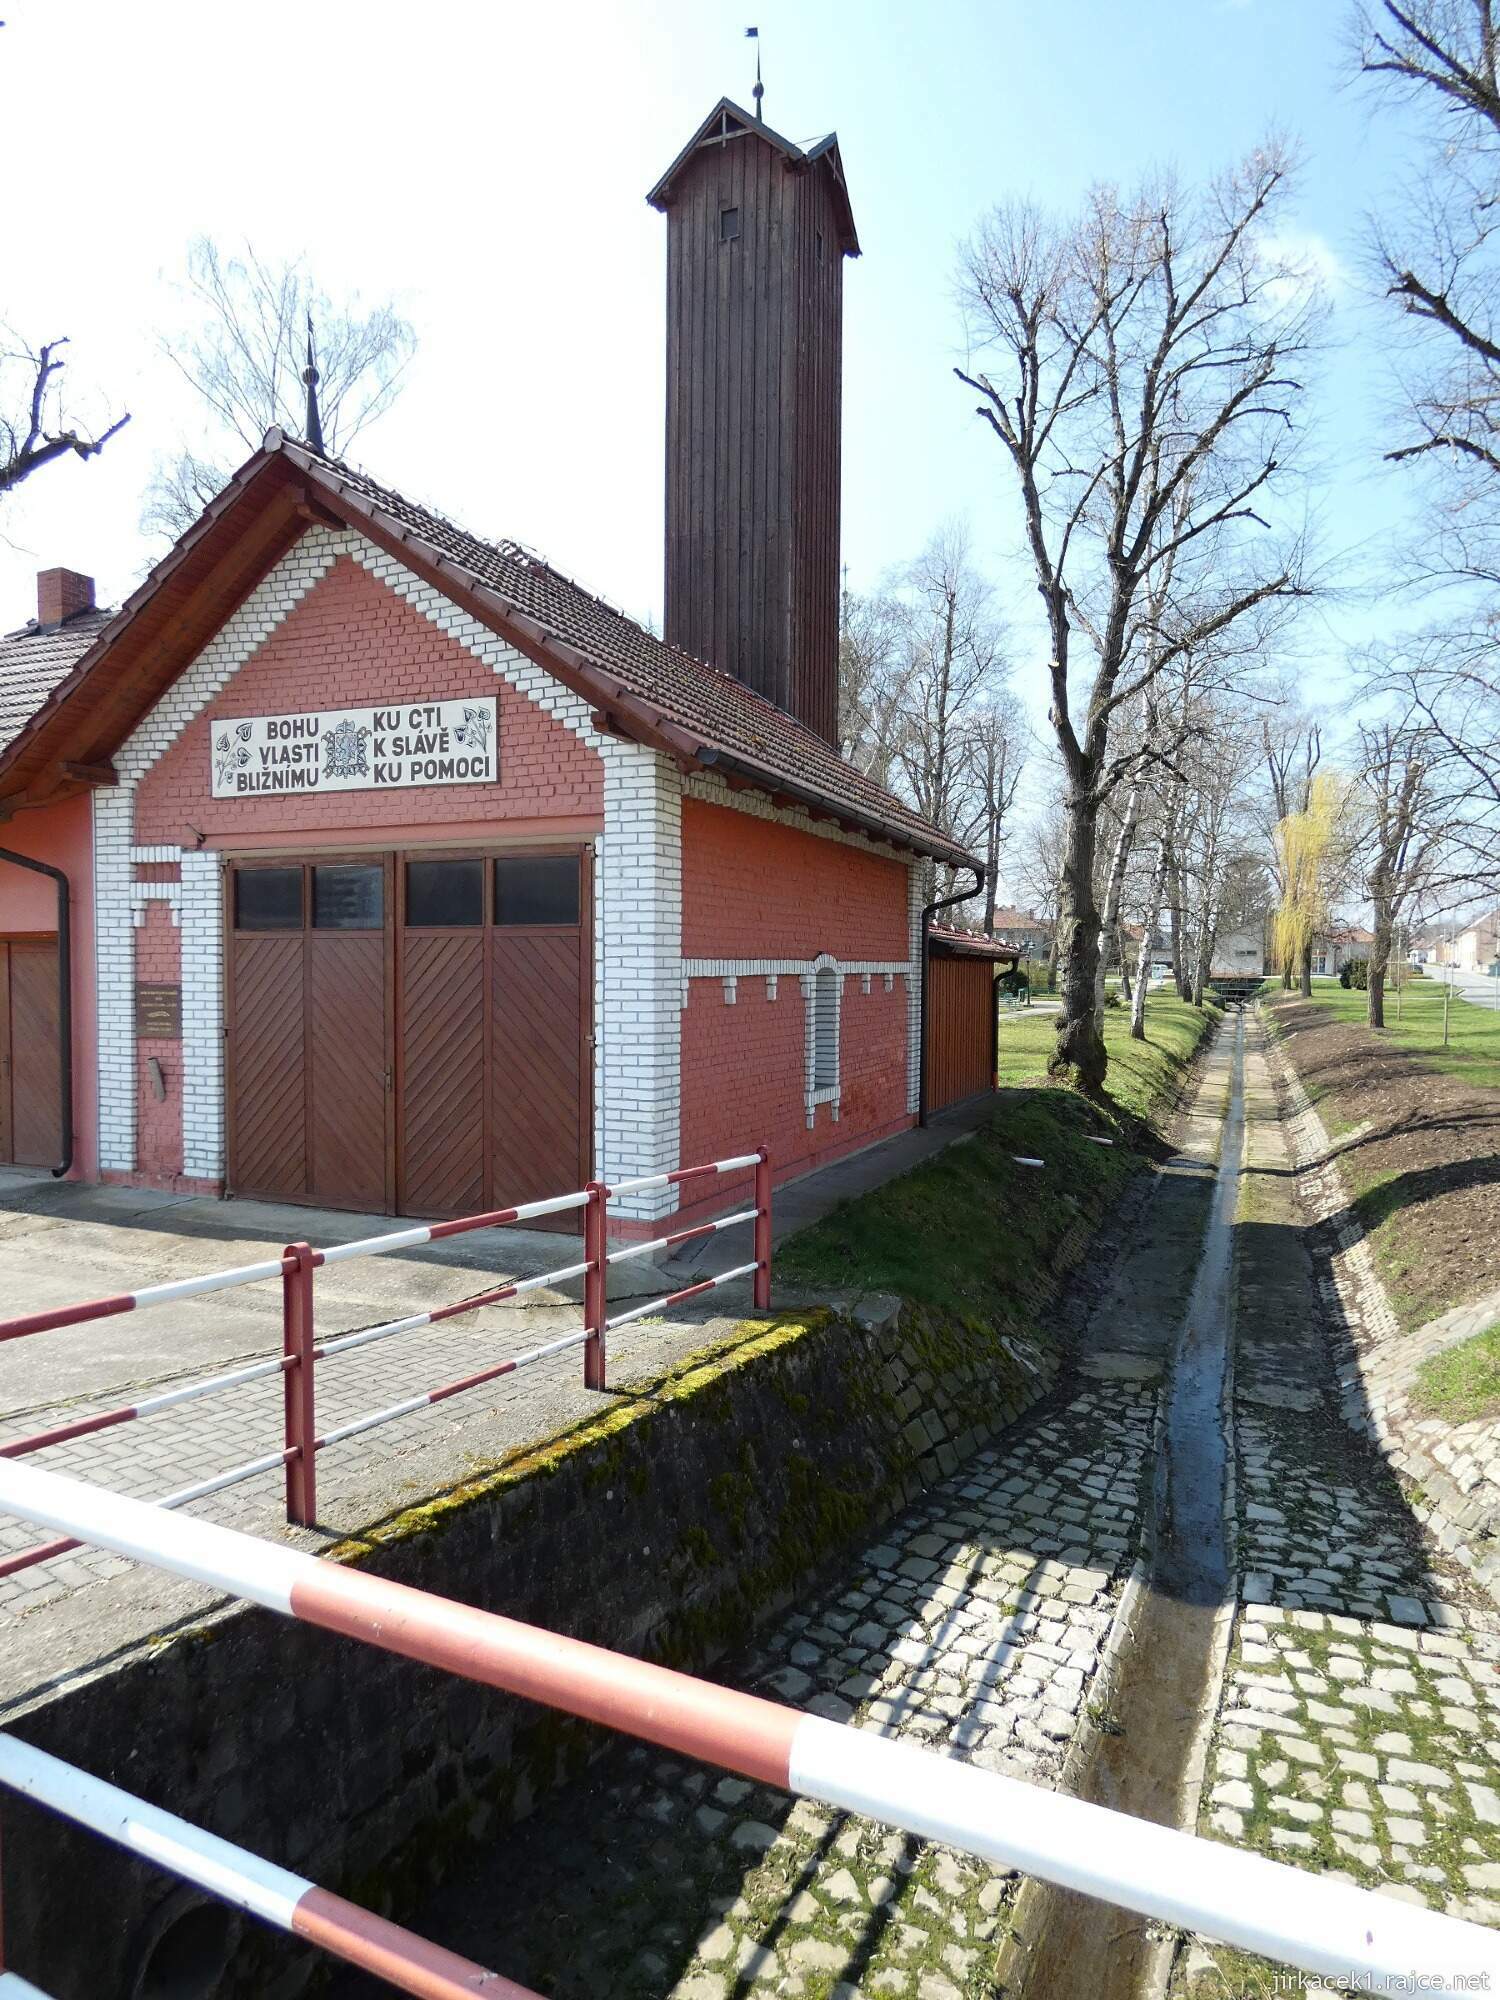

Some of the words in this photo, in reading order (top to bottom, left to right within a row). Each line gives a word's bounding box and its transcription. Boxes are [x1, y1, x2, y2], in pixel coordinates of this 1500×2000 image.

[267, 718, 319, 740] BOHU
[373, 710, 401, 733] KU
[408, 706, 441, 730] CTI
[259, 743, 319, 766] VLASTI
[373, 737, 387, 758] K
[391, 726, 449, 757] SLÁVĚ
[237, 764, 319, 792] BLIŽNÍMU
[373, 761, 402, 784] KU
[410, 755, 490, 782] POMOCI
